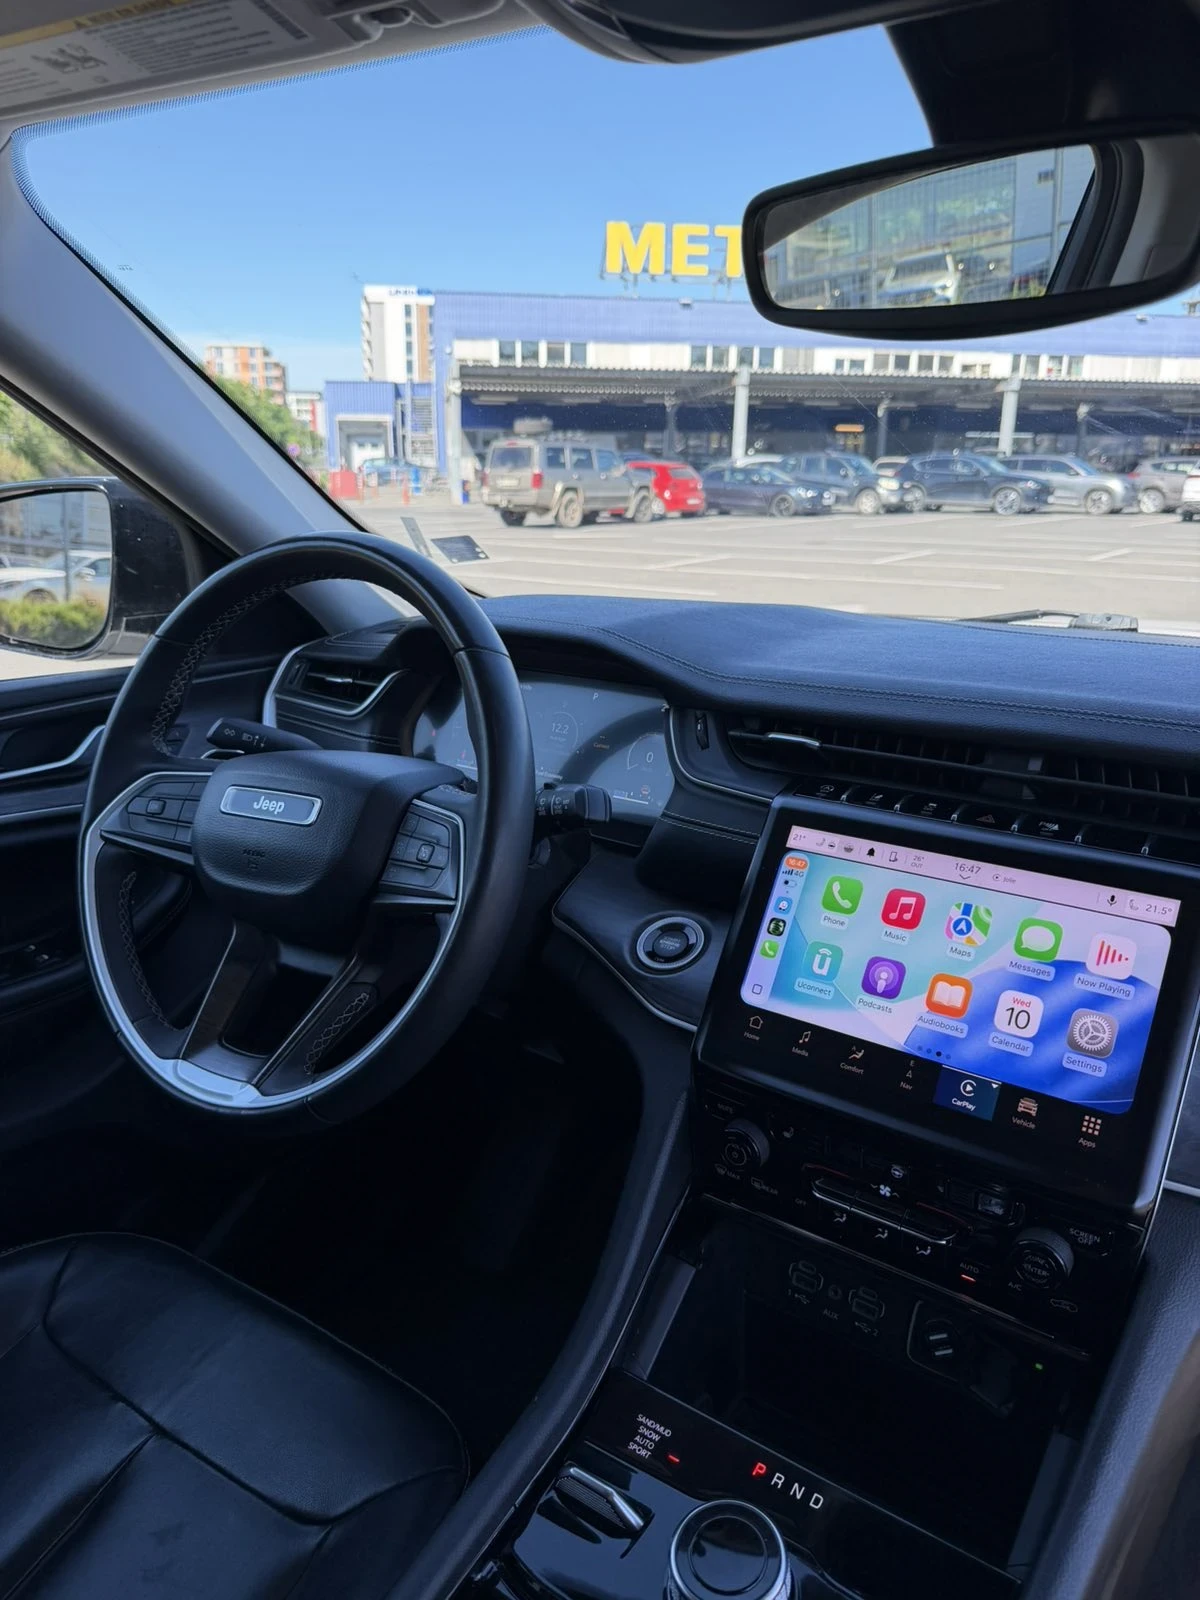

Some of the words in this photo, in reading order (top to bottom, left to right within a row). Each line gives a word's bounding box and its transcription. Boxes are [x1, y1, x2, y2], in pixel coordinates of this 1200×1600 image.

[253, 795, 285, 815] Jeep
[954, 861, 982, 875] 16:47
[823, 915, 846, 928] Phone
[884, 930, 907, 942] Music
[949, 946, 972, 959] Maps
[1008, 960, 1051, 978] Messages
[797, 980, 832, 997] Uconnect
[1077, 976, 1097, 988] Now
[1099, 982, 1132, 998] Playing
[858, 997, 893, 1014] Podcasts
[1012, 996, 1032, 1008] Wed
[918, 1015, 965, 1034] Audiobooks
[1005, 1007, 1031, 1030] 10
[744, 1031, 760, 1041] Home
[792, 1046, 809, 1057] Media
[991, 1035, 1030, 1053] Calendar
[839, 1061, 865, 1075] Comfort
[1065, 1056, 1103, 1074] Settings
[900, 1081, 913, 1091] Nav
[951, 1097, 976, 1112] CarPlay
[1011, 1116, 1036, 1130] Vehicle
[1078, 1136, 1096, 1149] Apps
[1069, 1227, 1101, 1244] SCREEN
[1077, 1235, 1095, 1246] OFF
[960, 1261, 980, 1274] AUTO
[1008, 1281, 1023, 1292] A/C
[823, 1307, 840, 1320] AUX
[636, 1413, 672, 1438] SAND/MUD
[637, 1425, 661, 1442] SNOW
[634, 1435, 655, 1450] AUTO
[627, 1442, 652, 1459] SPORT
[752, 1462, 767, 1476] P
[770, 1472, 785, 1489] R
[790, 1482, 805, 1500] N
[809, 1493, 824, 1510] D
